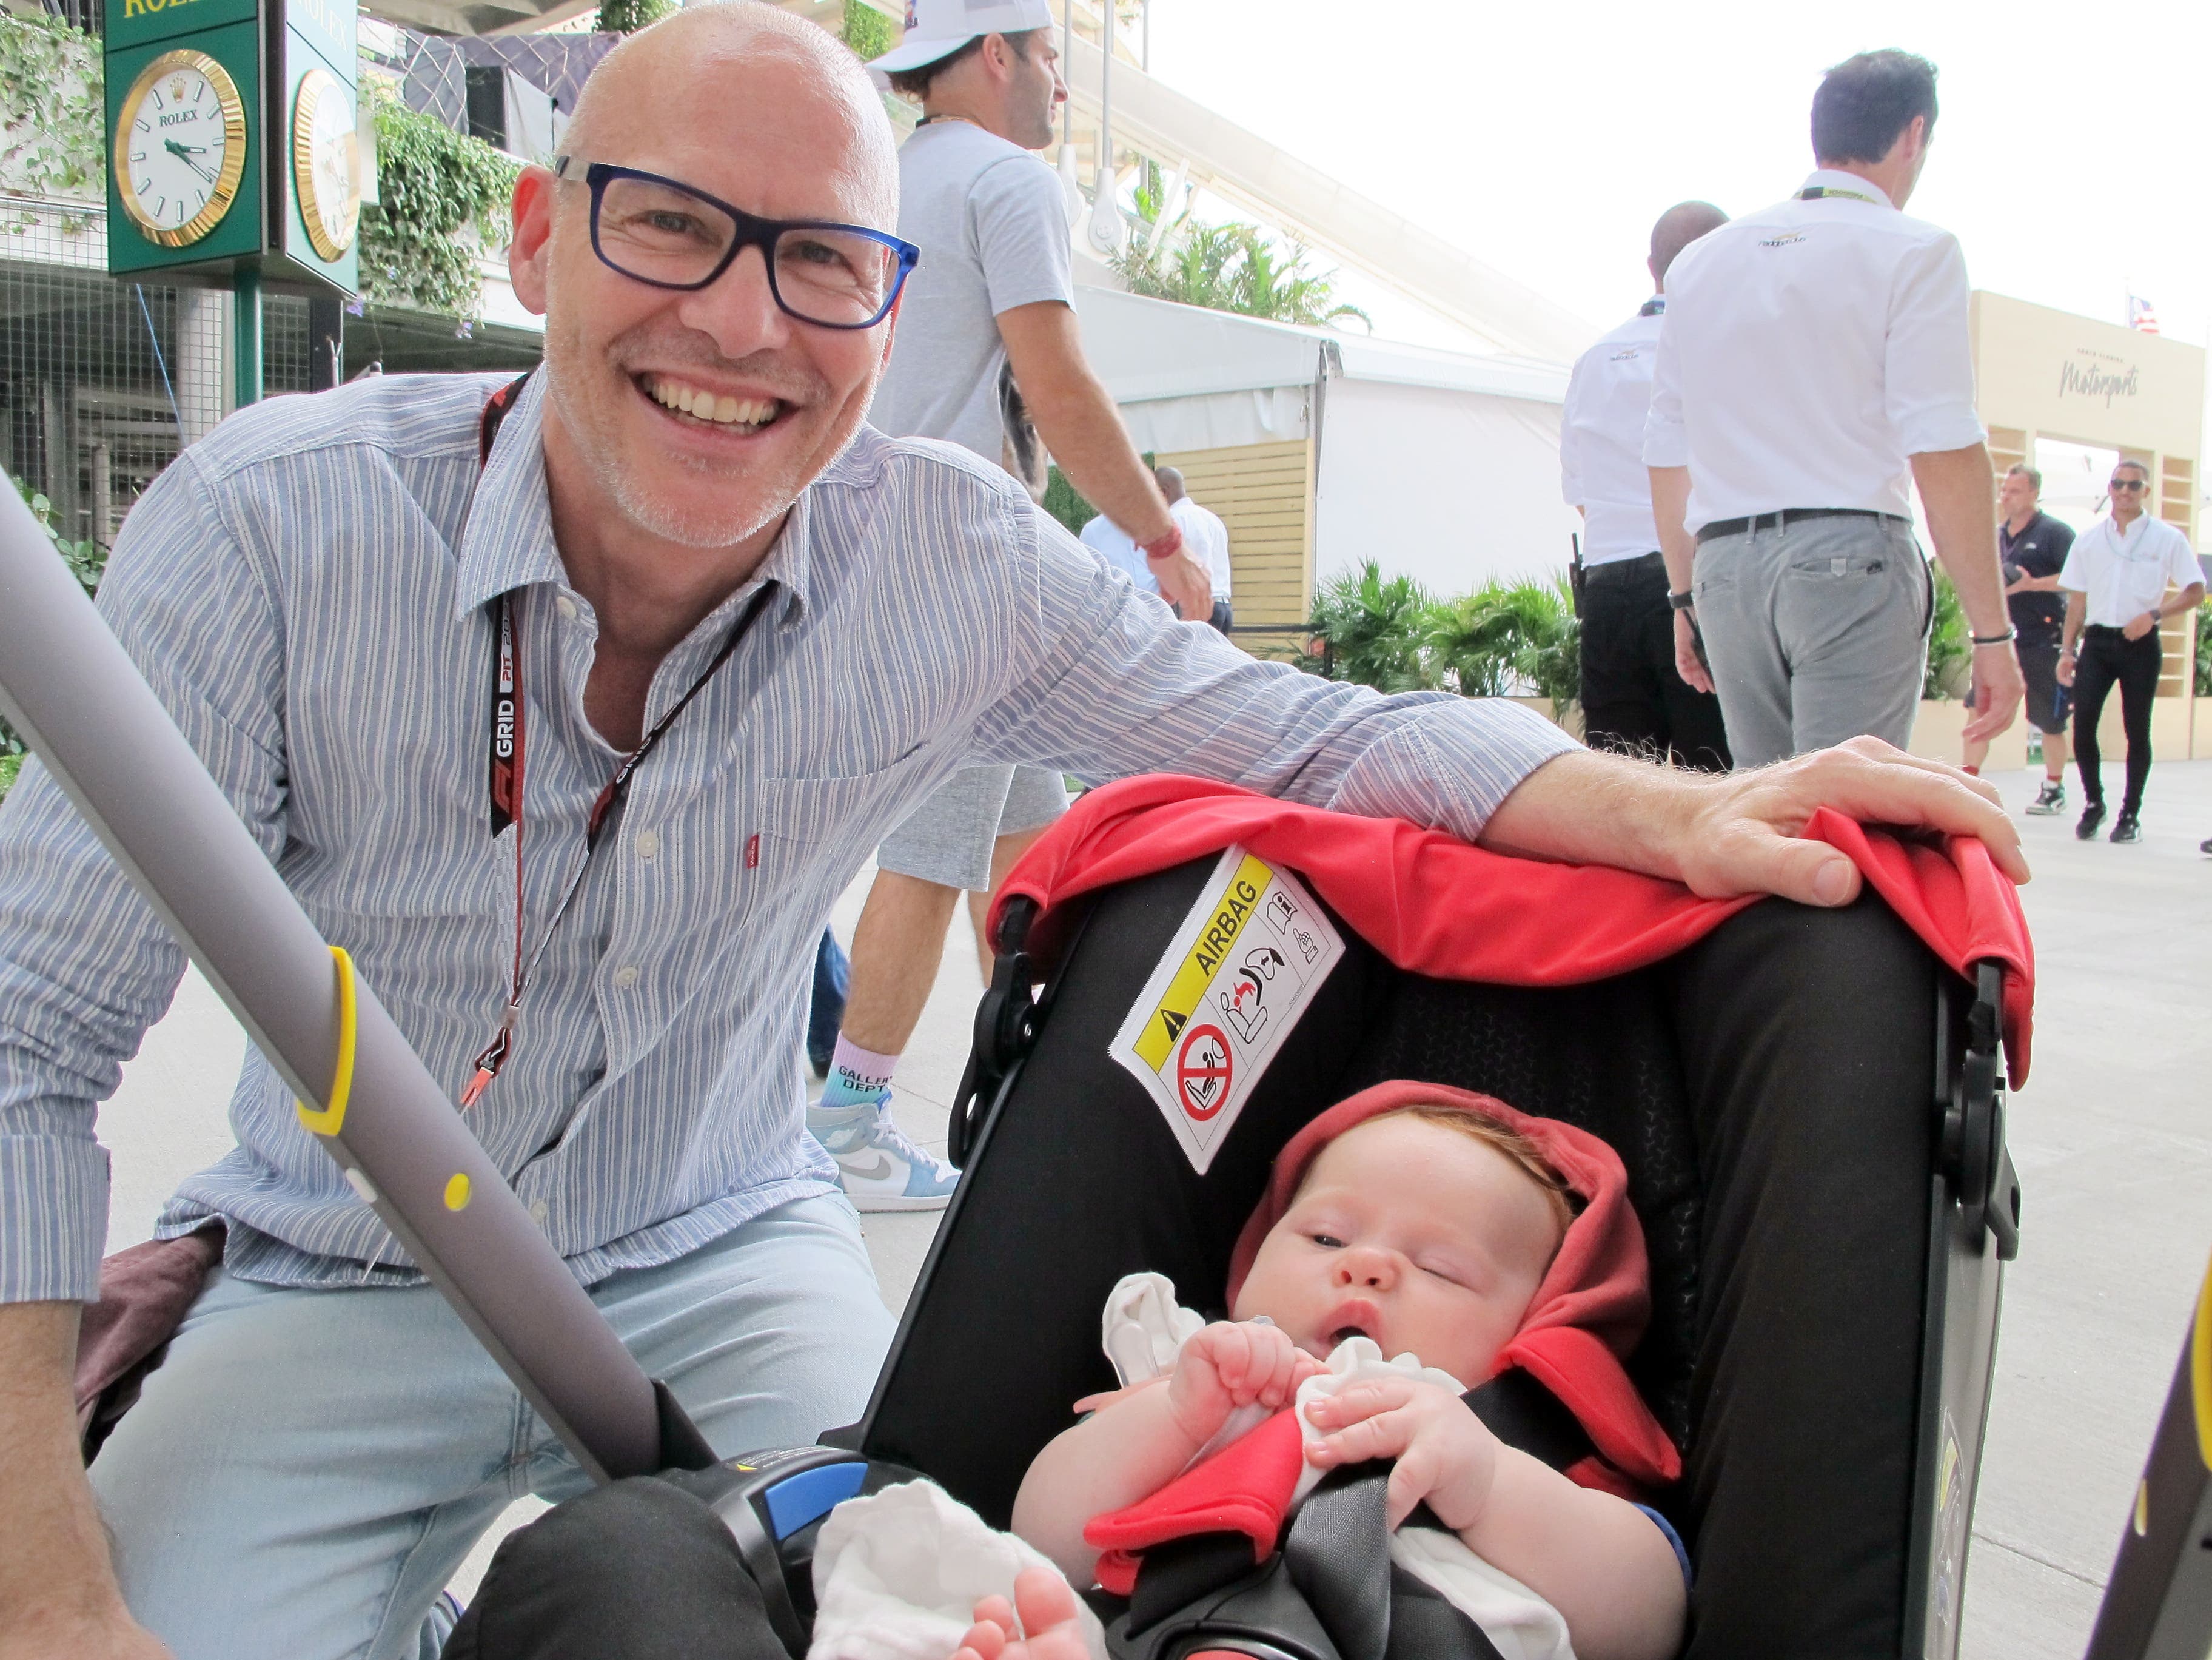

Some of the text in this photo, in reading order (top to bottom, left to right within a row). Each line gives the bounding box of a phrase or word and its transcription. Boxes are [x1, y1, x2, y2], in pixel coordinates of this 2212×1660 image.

[159, 110, 198, 127] ROLEX
[503, 654, 511, 681] PIT
[497, 700, 514, 758] GRID
[1196, 881, 1256, 977] AIRBAG
[839, 1066, 893, 1084] GALLER
[844, 1079, 885, 1092] DEPT
